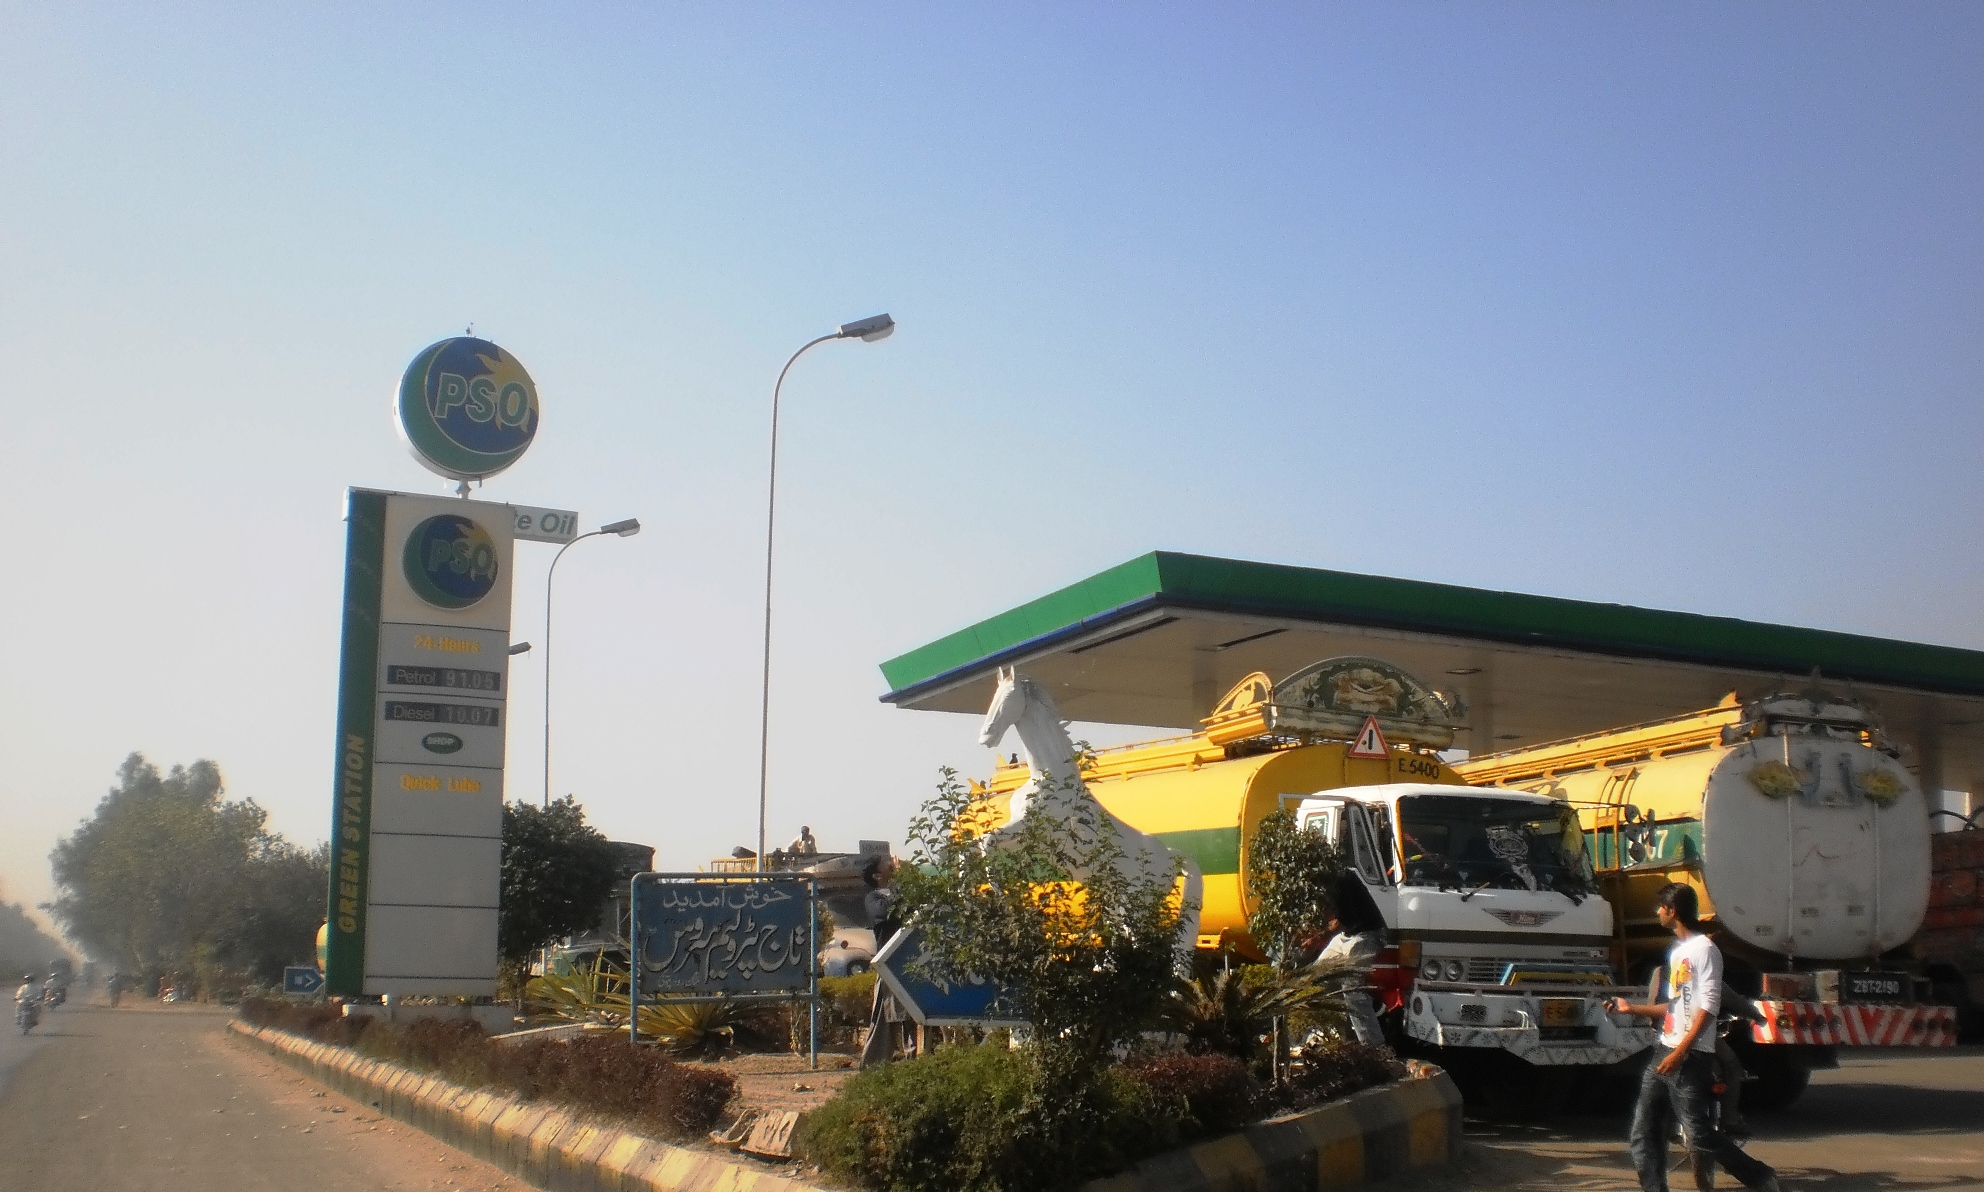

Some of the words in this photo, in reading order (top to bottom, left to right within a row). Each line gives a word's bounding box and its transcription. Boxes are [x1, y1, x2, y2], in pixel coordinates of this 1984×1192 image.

[434, 372, 529, 426] PSO
[541, 513, 575, 535] Oil
[428, 538, 494, 576] PSO
[396, 669, 436, 685] Petrol
[394, 705, 435, 721] Diesel
[1410, 760, 1440, 779] 5400
[342, 734, 364, 842] STATION
[402, 774, 440, 791] Quick
[338, 848, 360, 934] GREEN
[728, 885, 793, 909] خوش
[758, 924, 806, 972] تاج
